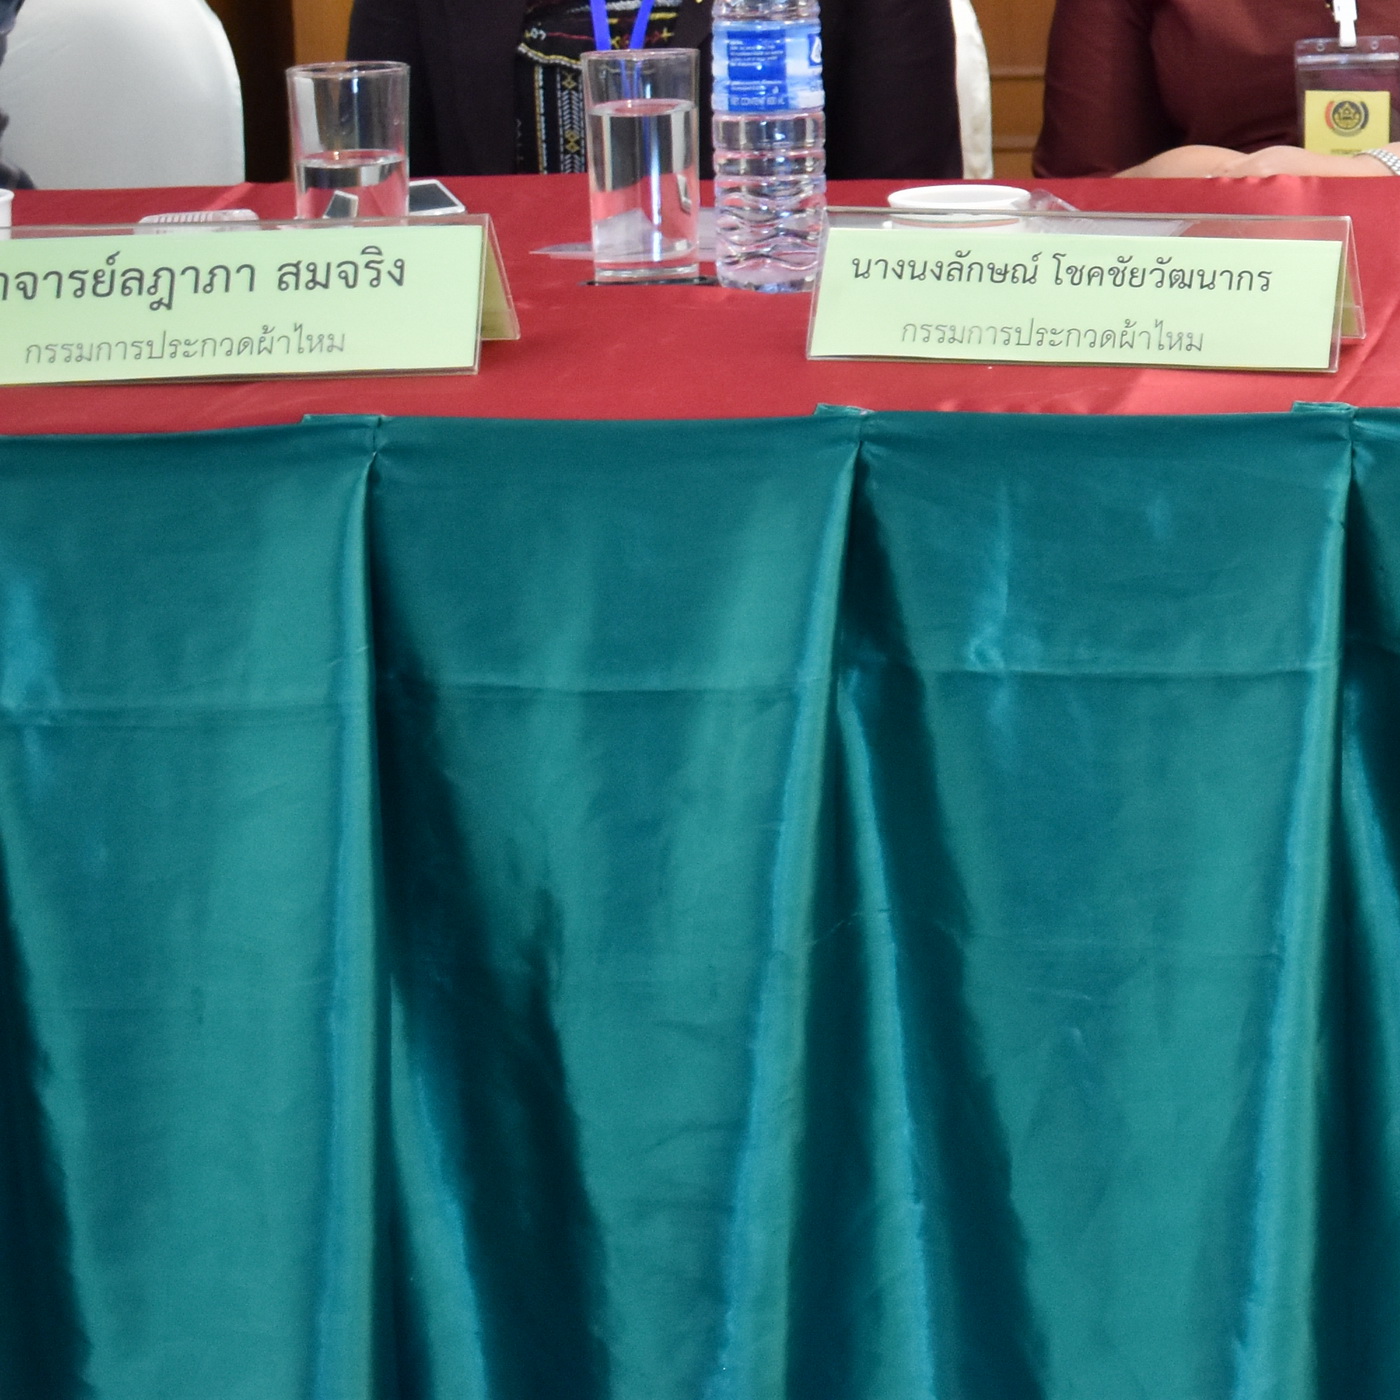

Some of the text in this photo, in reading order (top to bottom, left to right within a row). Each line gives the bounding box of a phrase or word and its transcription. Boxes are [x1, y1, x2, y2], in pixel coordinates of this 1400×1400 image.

[276, 244, 406, 292] สมจริง
[851, 249, 1273, 293] นางนงลักษณ์ โชคชัยวัฒนากร
[25, 322, 346, 364] กรรมการประกวดผ้าไหม
[901, 317, 1204, 353] กรรมการประกวดผ้าไหม
